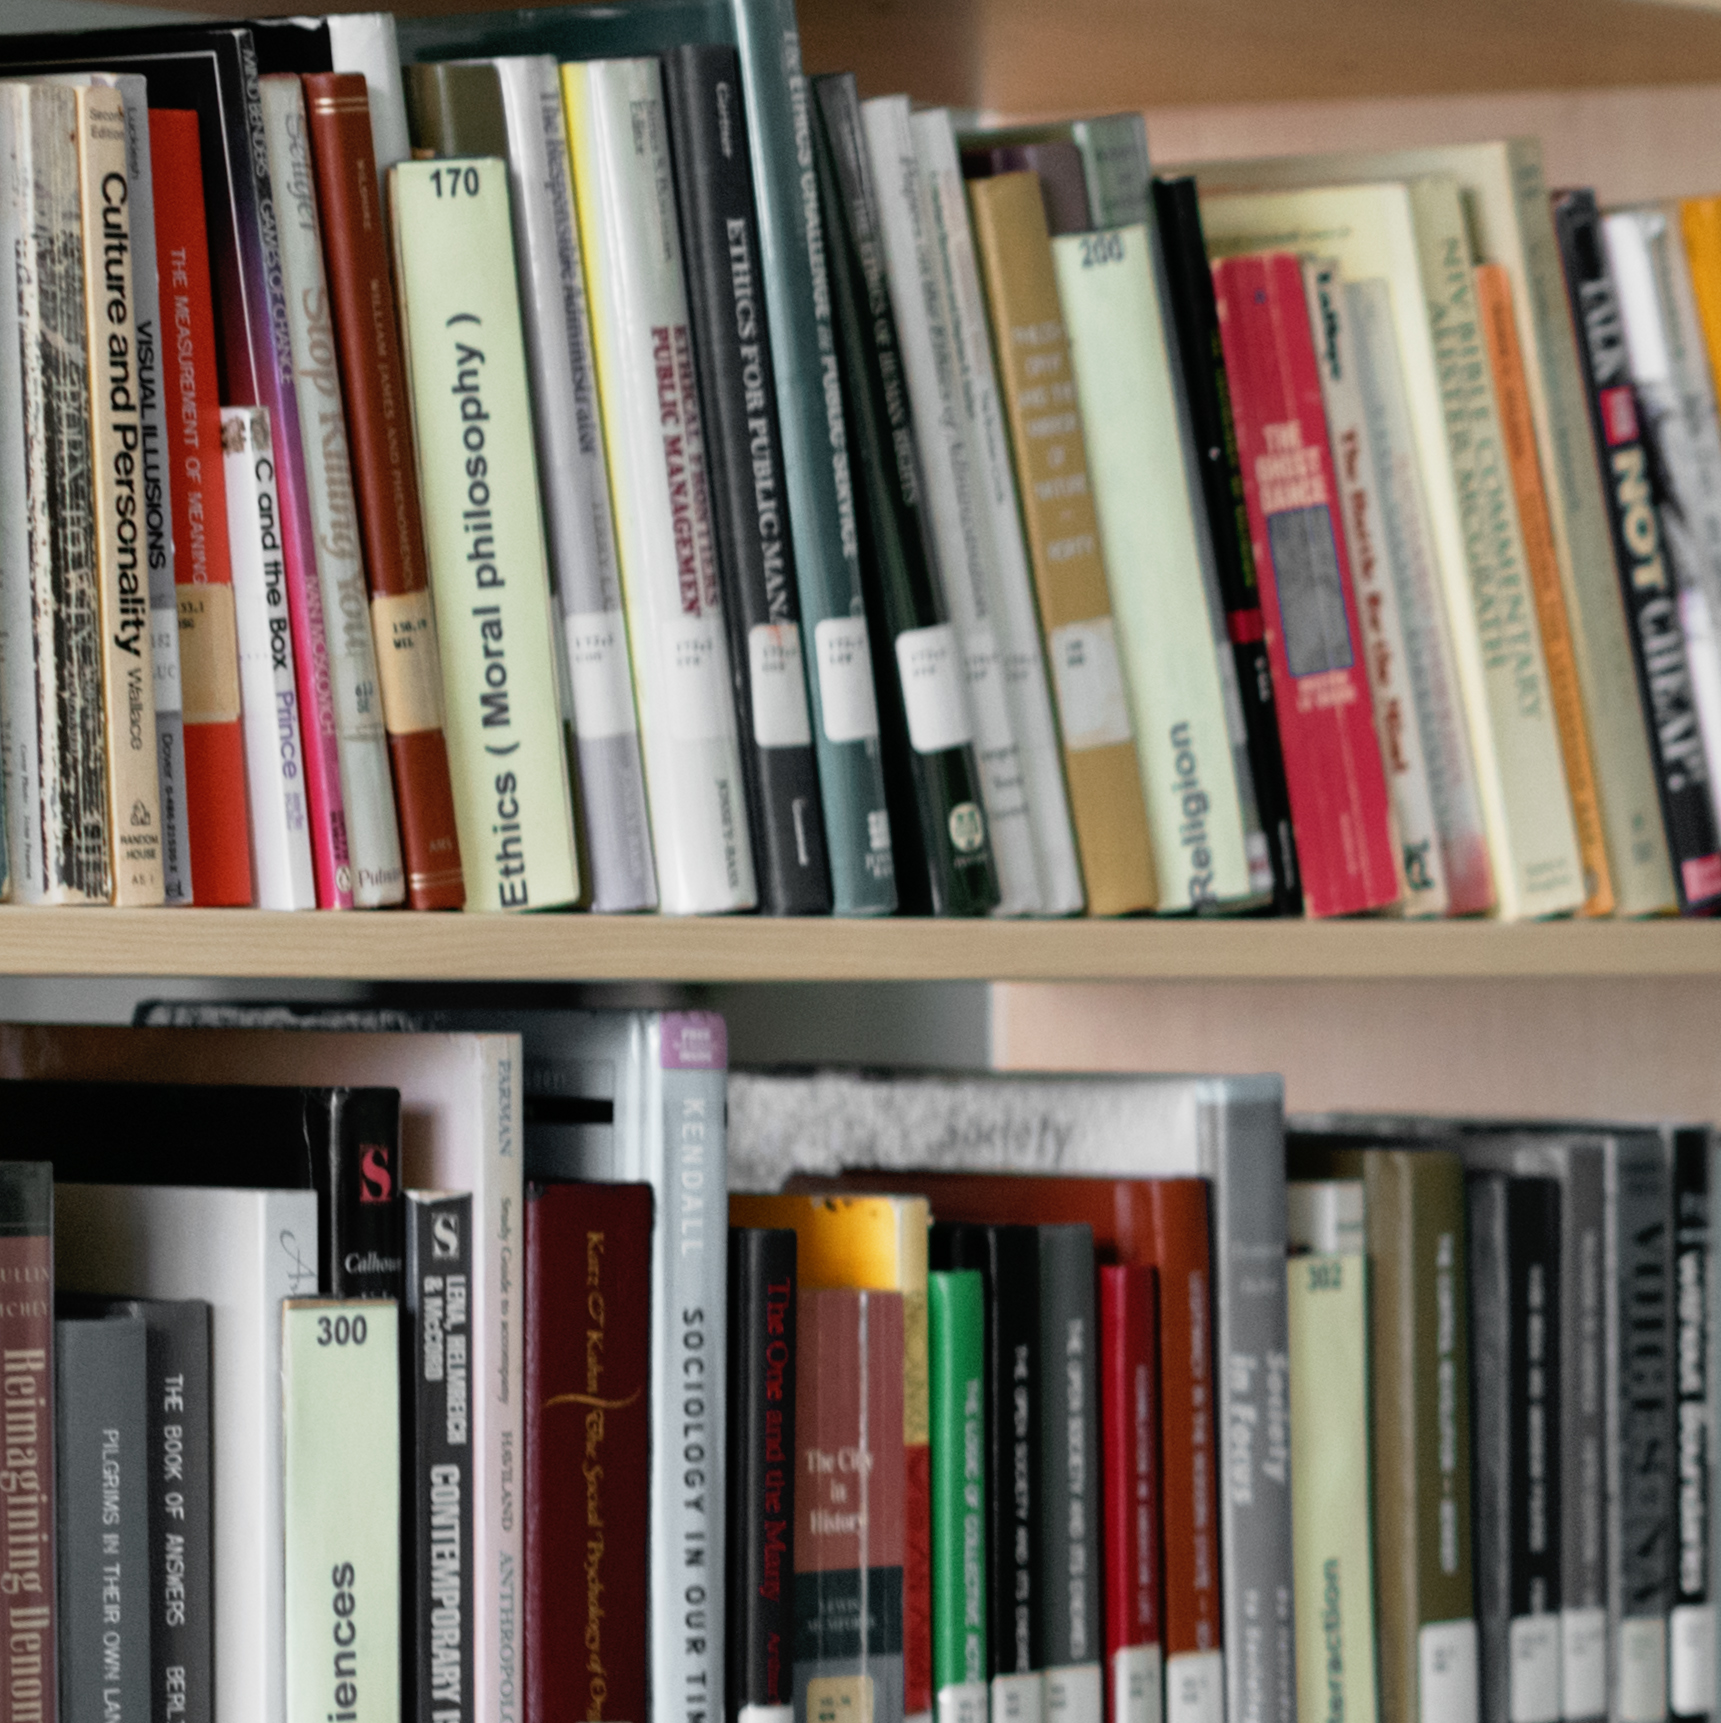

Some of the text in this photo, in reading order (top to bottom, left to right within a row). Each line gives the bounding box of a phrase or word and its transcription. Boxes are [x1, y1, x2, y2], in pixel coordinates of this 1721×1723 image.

[239, 47, 259, 101] MIND
[788, 74, 813, 165] ETHICS
[430, 167, 480, 199] 170
[258, 198, 280, 265] GAMES
[1079, 235, 1125, 270] 200
[267, 268, 285, 299] OF
[271, 300, 295, 384] CHANCE
[650, 323, 679, 427] PUBLIC
[725, 217, 780, 535] ETHICS FOR PUBLIC
[100, 172, 146, 657] Culture and Personality
[134, 319, 165, 570] VISUAL ILLUSIONS
[169, 246, 209, 584] THE MEASUREMENT OF MEANING
[291, 283, 359, 563] Stop Killing
[819, 353, 846, 448] PUBLIC
[257, 491, 280, 551] and
[831, 452, 858, 558] SERVICE
[1608, 446, 1668, 593] NOT
[263, 560, 285, 606] the
[447, 338, 529, 909] Ethics Moral philosophy
[269, 616, 290, 671] Box
[125, 667, 143, 750] Wallace
[275, 687, 300, 778] Prince
[126, 848, 157, 860] HOUSE
[1164, 720, 1221, 902] Religion
[678, 1095, 705, 1255] KENDALL
[422, 1275, 442, 1292] &
[317, 1314, 368, 1346] 300
[446, 1334, 466, 1444] HELMREICH
[681, 1308, 706, 1512] SOCIOLOGY
[0, 1347, 50, 1594] Reimagining
[101, 1429, 118, 1525] PILGRIMS
[758, 1277, 790, 1602] The One and the Many
[807, 1449, 835, 1475] The
[102, 1534, 118, 1553] IN
[162, 1373, 184, 1626] THE BOOK OF ANSWERS
[810, 1507, 867, 1536] History
[102, 1563, 119, 1623] THEIR
[428, 1463, 461, 1702] CONTEMPORARY
[682, 1532, 707, 1566] IN
[103, 1631, 119, 1679] OWN
[683, 1586, 707, 1656] OUR
